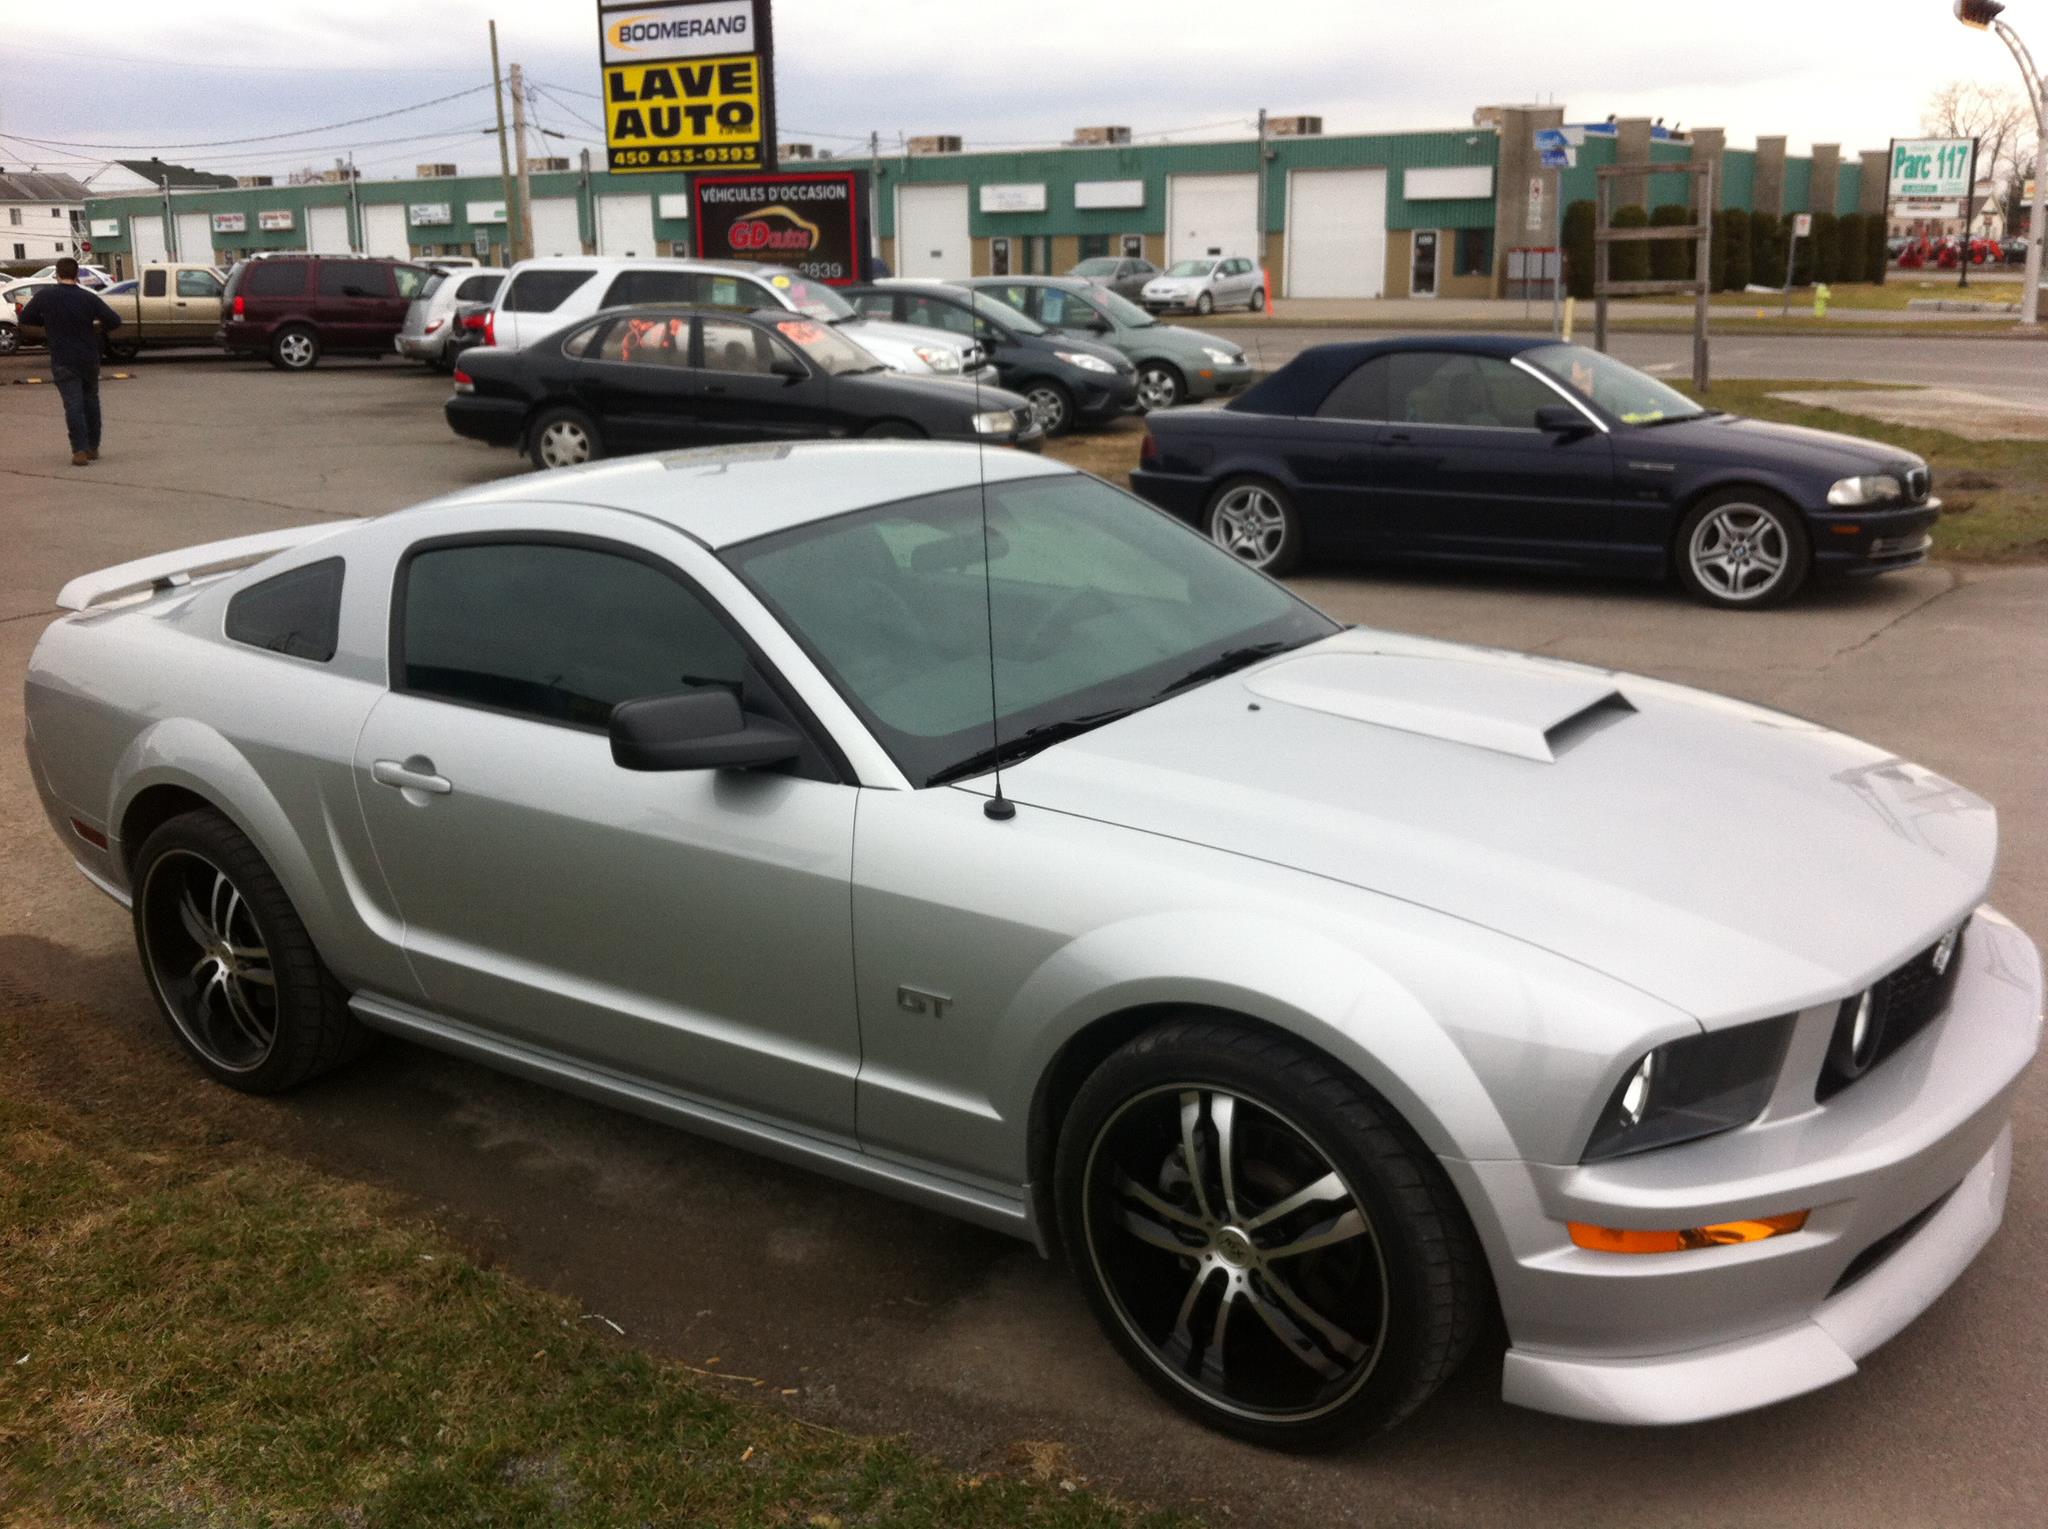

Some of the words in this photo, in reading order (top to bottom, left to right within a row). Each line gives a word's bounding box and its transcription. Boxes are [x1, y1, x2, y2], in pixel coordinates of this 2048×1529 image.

[619, 15, 746, 43] BOOMERANG
[609, 62, 753, 104] LAVE
[613, 101, 754, 140] AUTO
[614, 150, 650, 165] 450
[657, 147, 756, 164] 433-9393
[1893, 146, 1931, 179] Parc
[1937, 146, 1968, 178] 117
[701, 186, 765, 203] VÉHICULES
[768, 184, 847, 200] D'OCCASION
[897, 985, 953, 1019] GT
